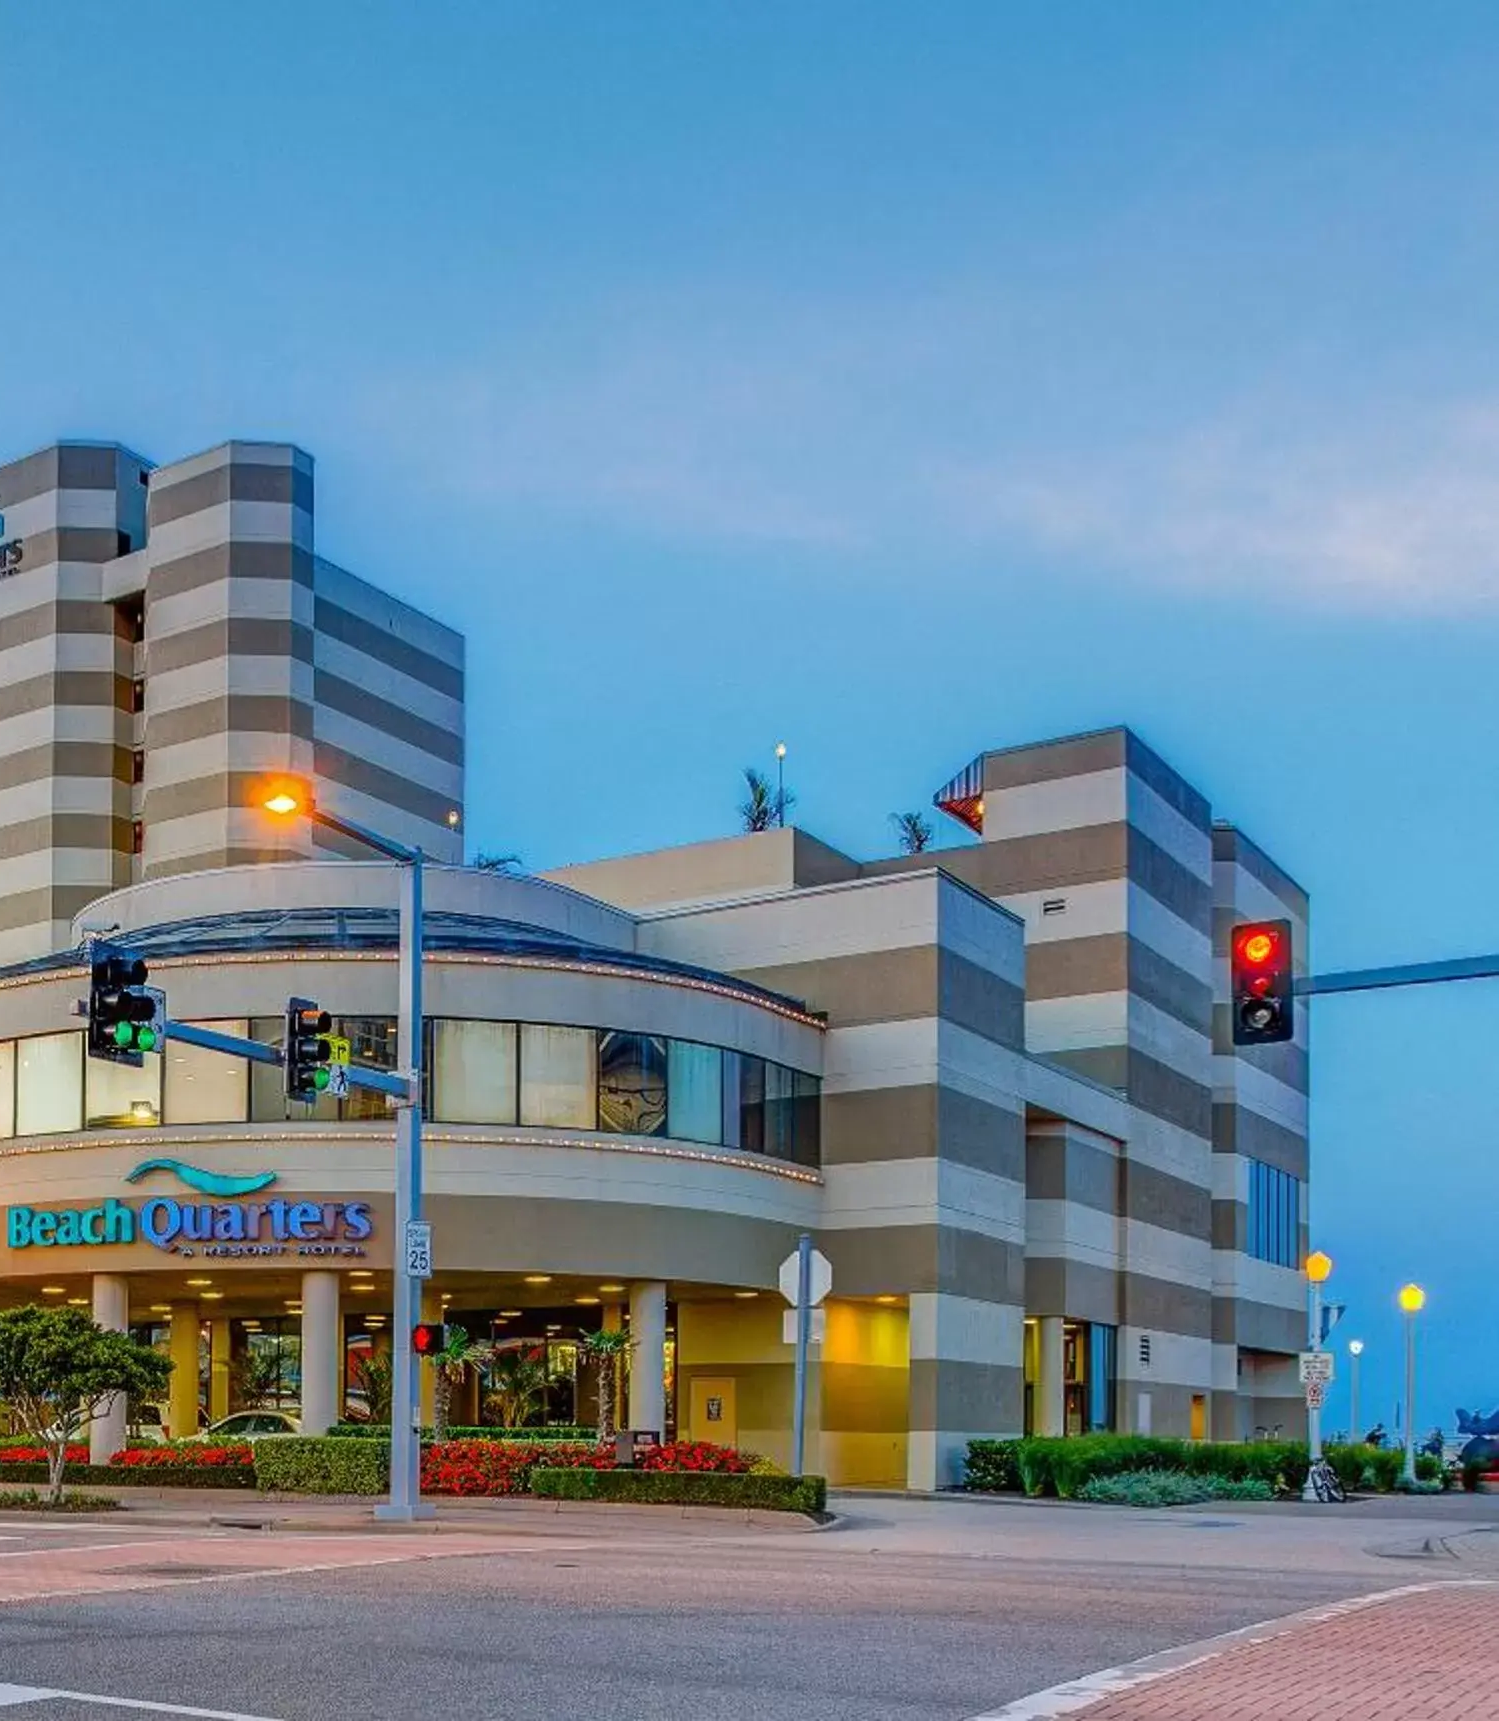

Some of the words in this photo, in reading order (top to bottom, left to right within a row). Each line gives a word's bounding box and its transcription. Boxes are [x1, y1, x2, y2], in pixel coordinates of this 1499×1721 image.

[8, 1197, 134, 1248] Beach
[141, 1197, 374, 1253] Quarters
[203, 1245, 286, 1258] RESORT
[298, 1245, 367, 1258] HOTEL
[410, 1250, 429, 1270] 25
